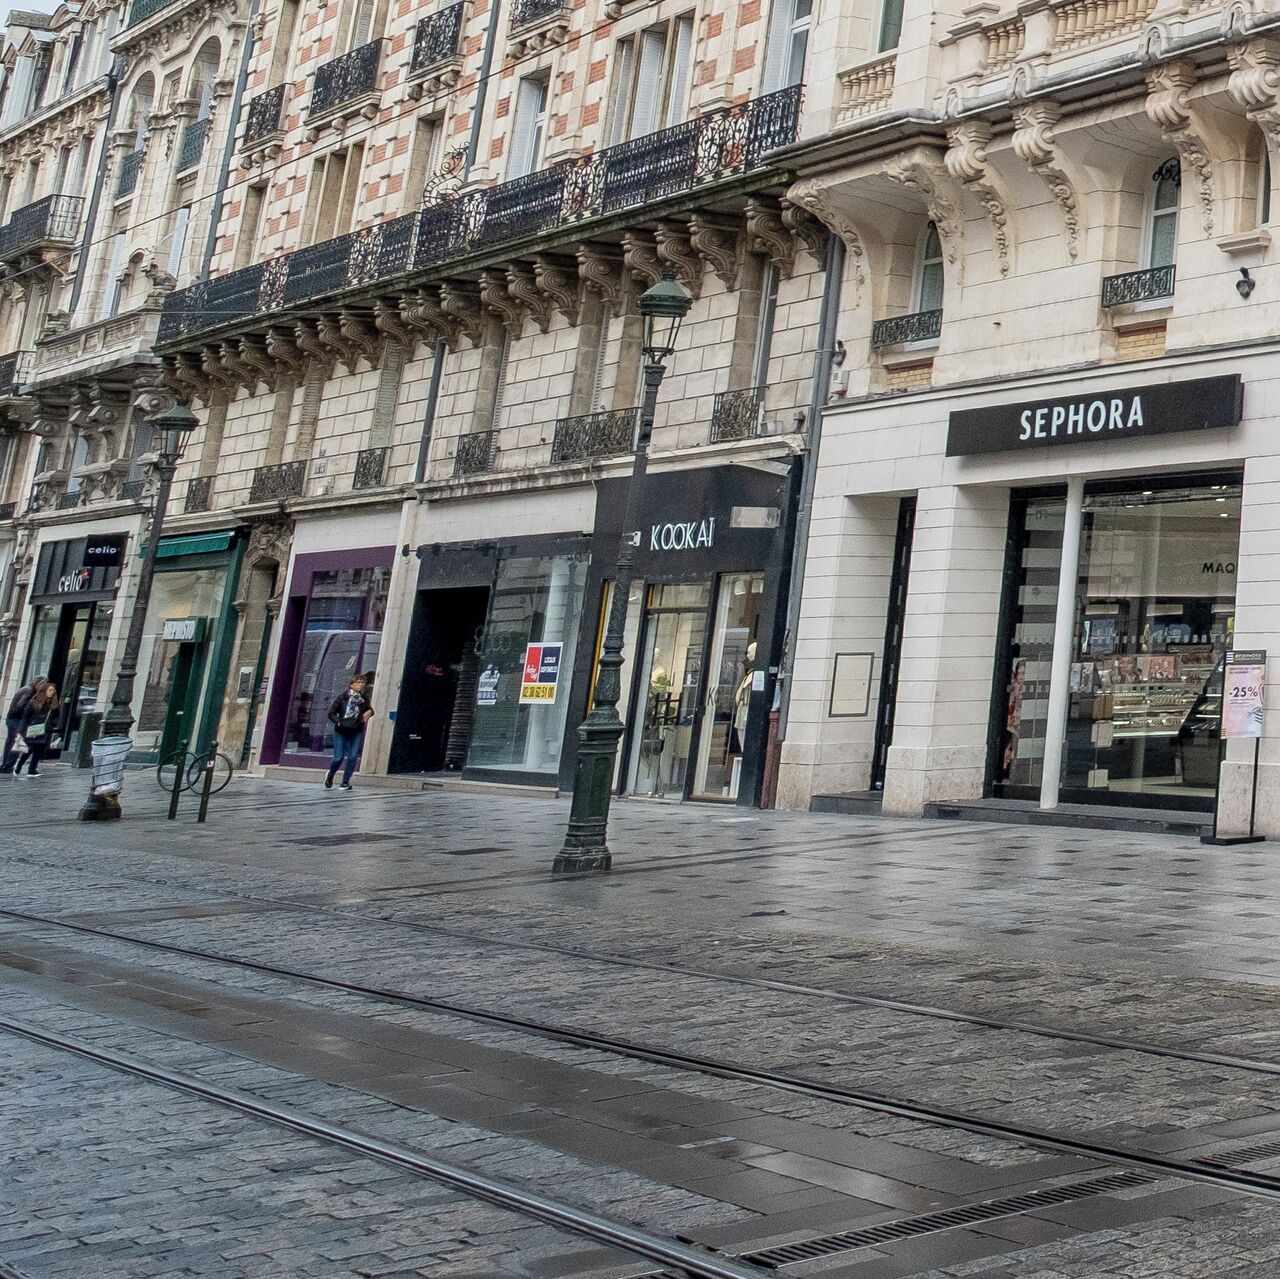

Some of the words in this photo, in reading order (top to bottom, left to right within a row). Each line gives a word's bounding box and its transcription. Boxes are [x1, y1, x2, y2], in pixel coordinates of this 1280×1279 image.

[1019, 395, 1144, 441] SEPHORA
[88, 545, 117, 554] celio
[1229, 686, 1259, 698] -25%
